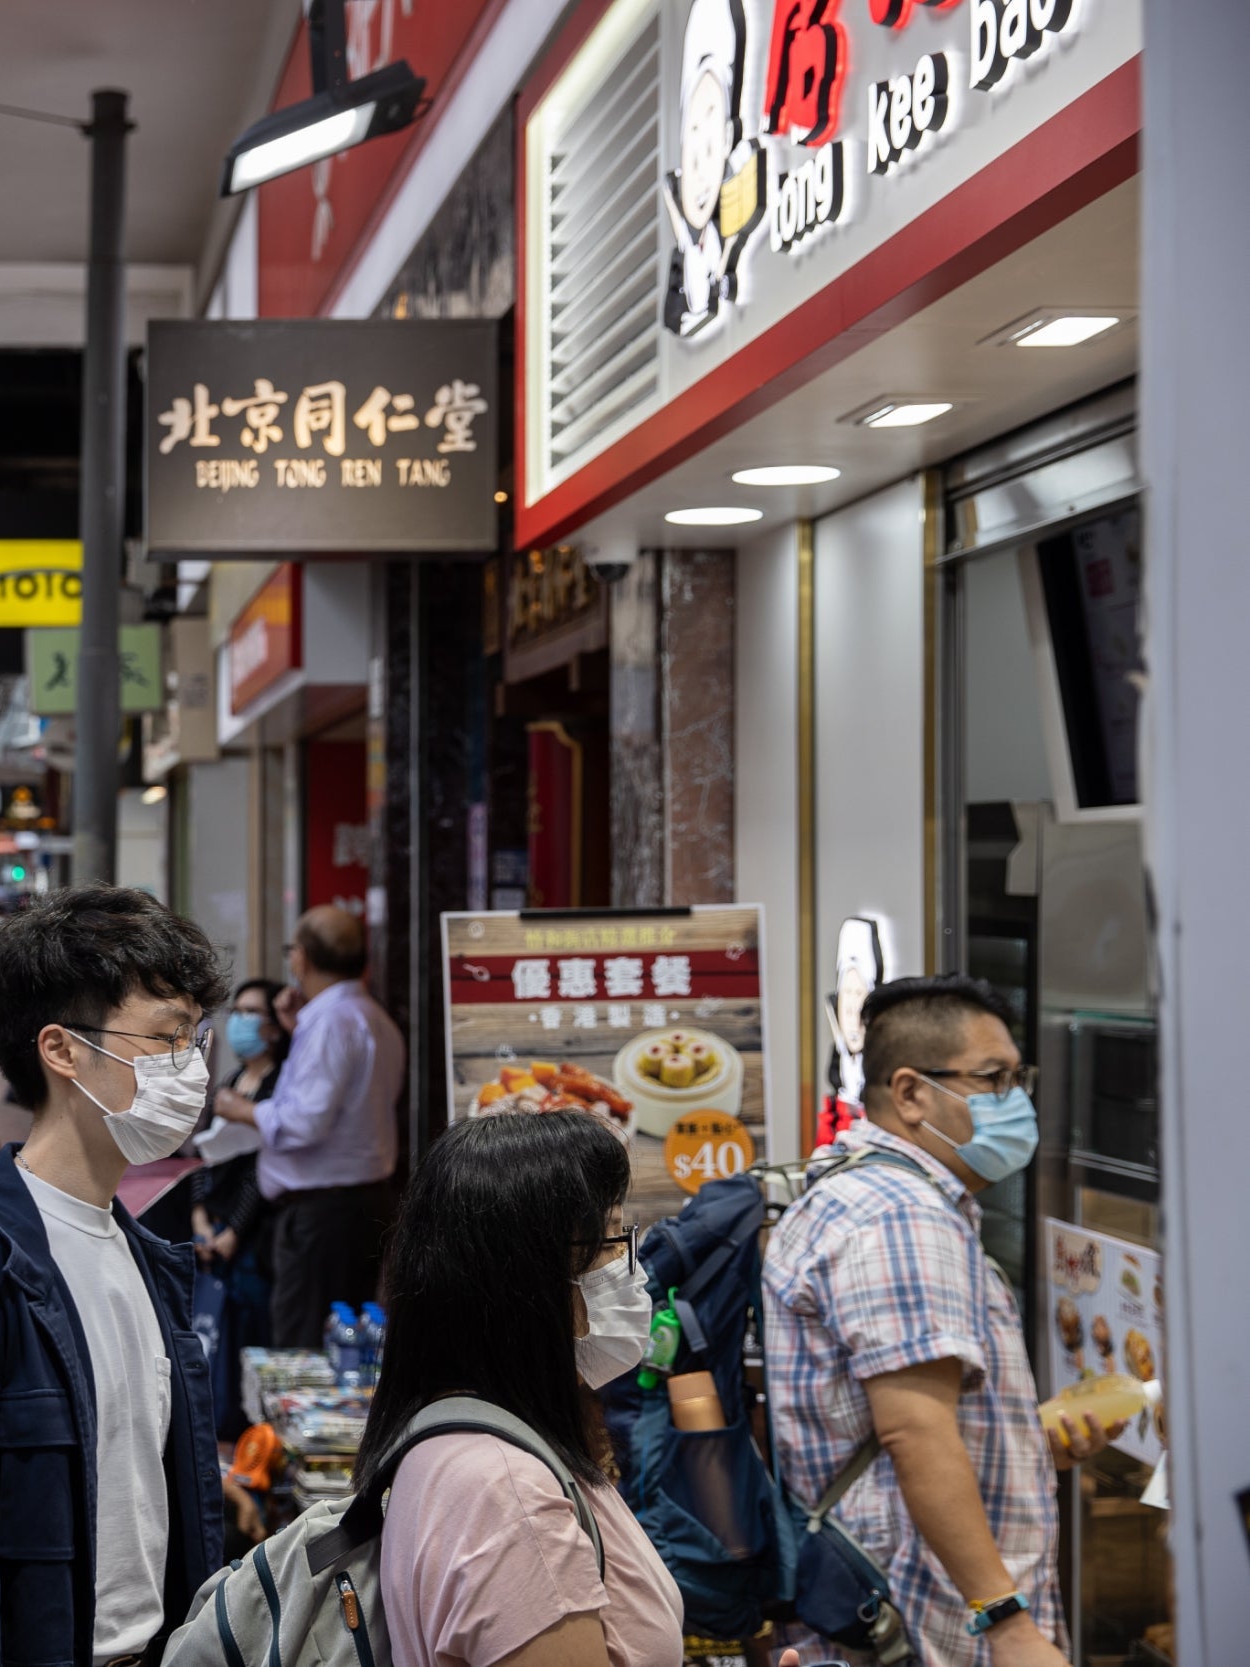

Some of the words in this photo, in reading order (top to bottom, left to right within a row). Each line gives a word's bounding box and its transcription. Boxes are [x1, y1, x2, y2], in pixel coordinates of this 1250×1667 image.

[770, 140, 845, 253] tong
[867, 53, 949, 175] kee
[157, 378, 488, 456] 北京同仁堂
[196, 459, 260, 492] BEIJING
[275, 459, 326, 488] TONG
[342, 459, 382, 487] REN
[397, 458, 451, 488] TANG
[512, 955, 692, 999] 優惠套餐
[539, 1003, 667, 1030] 香港製造
[674, 1141, 745, 1179] $40
